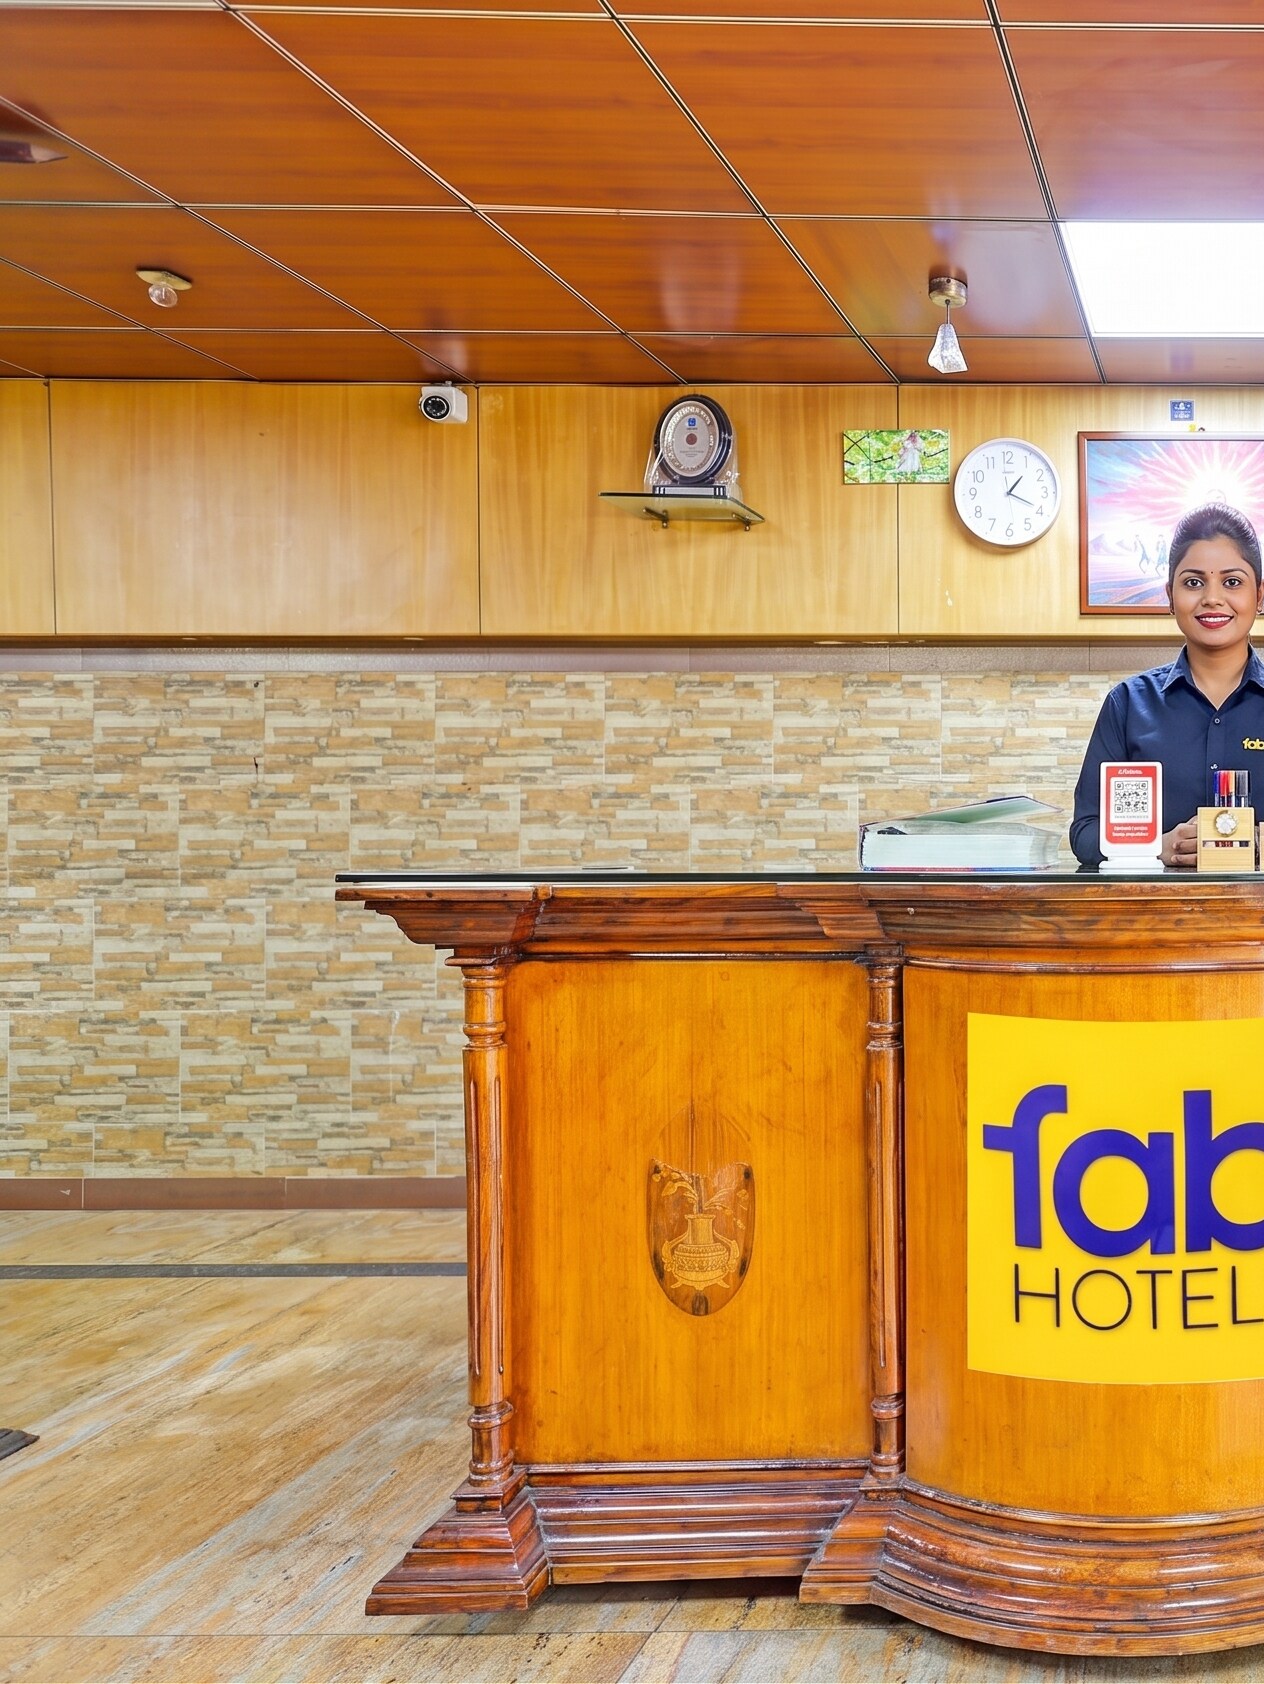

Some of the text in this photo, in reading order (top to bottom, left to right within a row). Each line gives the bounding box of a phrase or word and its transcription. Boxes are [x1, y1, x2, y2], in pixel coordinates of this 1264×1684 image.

[985, 456, 995, 470] 11
[1002, 451, 1014, 465] 12
[972, 469, 985, 483] 10
[1035, 469, 1045, 482] 2
[969, 487, 978, 501] 9
[1040, 486, 1049, 499] 3
[974, 505, 983, 519] 8
[1035, 504, 1044, 517] 4
[988, 518, 997, 532] 7
[1005, 522, 1014, 537] 6
[1023, 517, 1032, 531] 5
